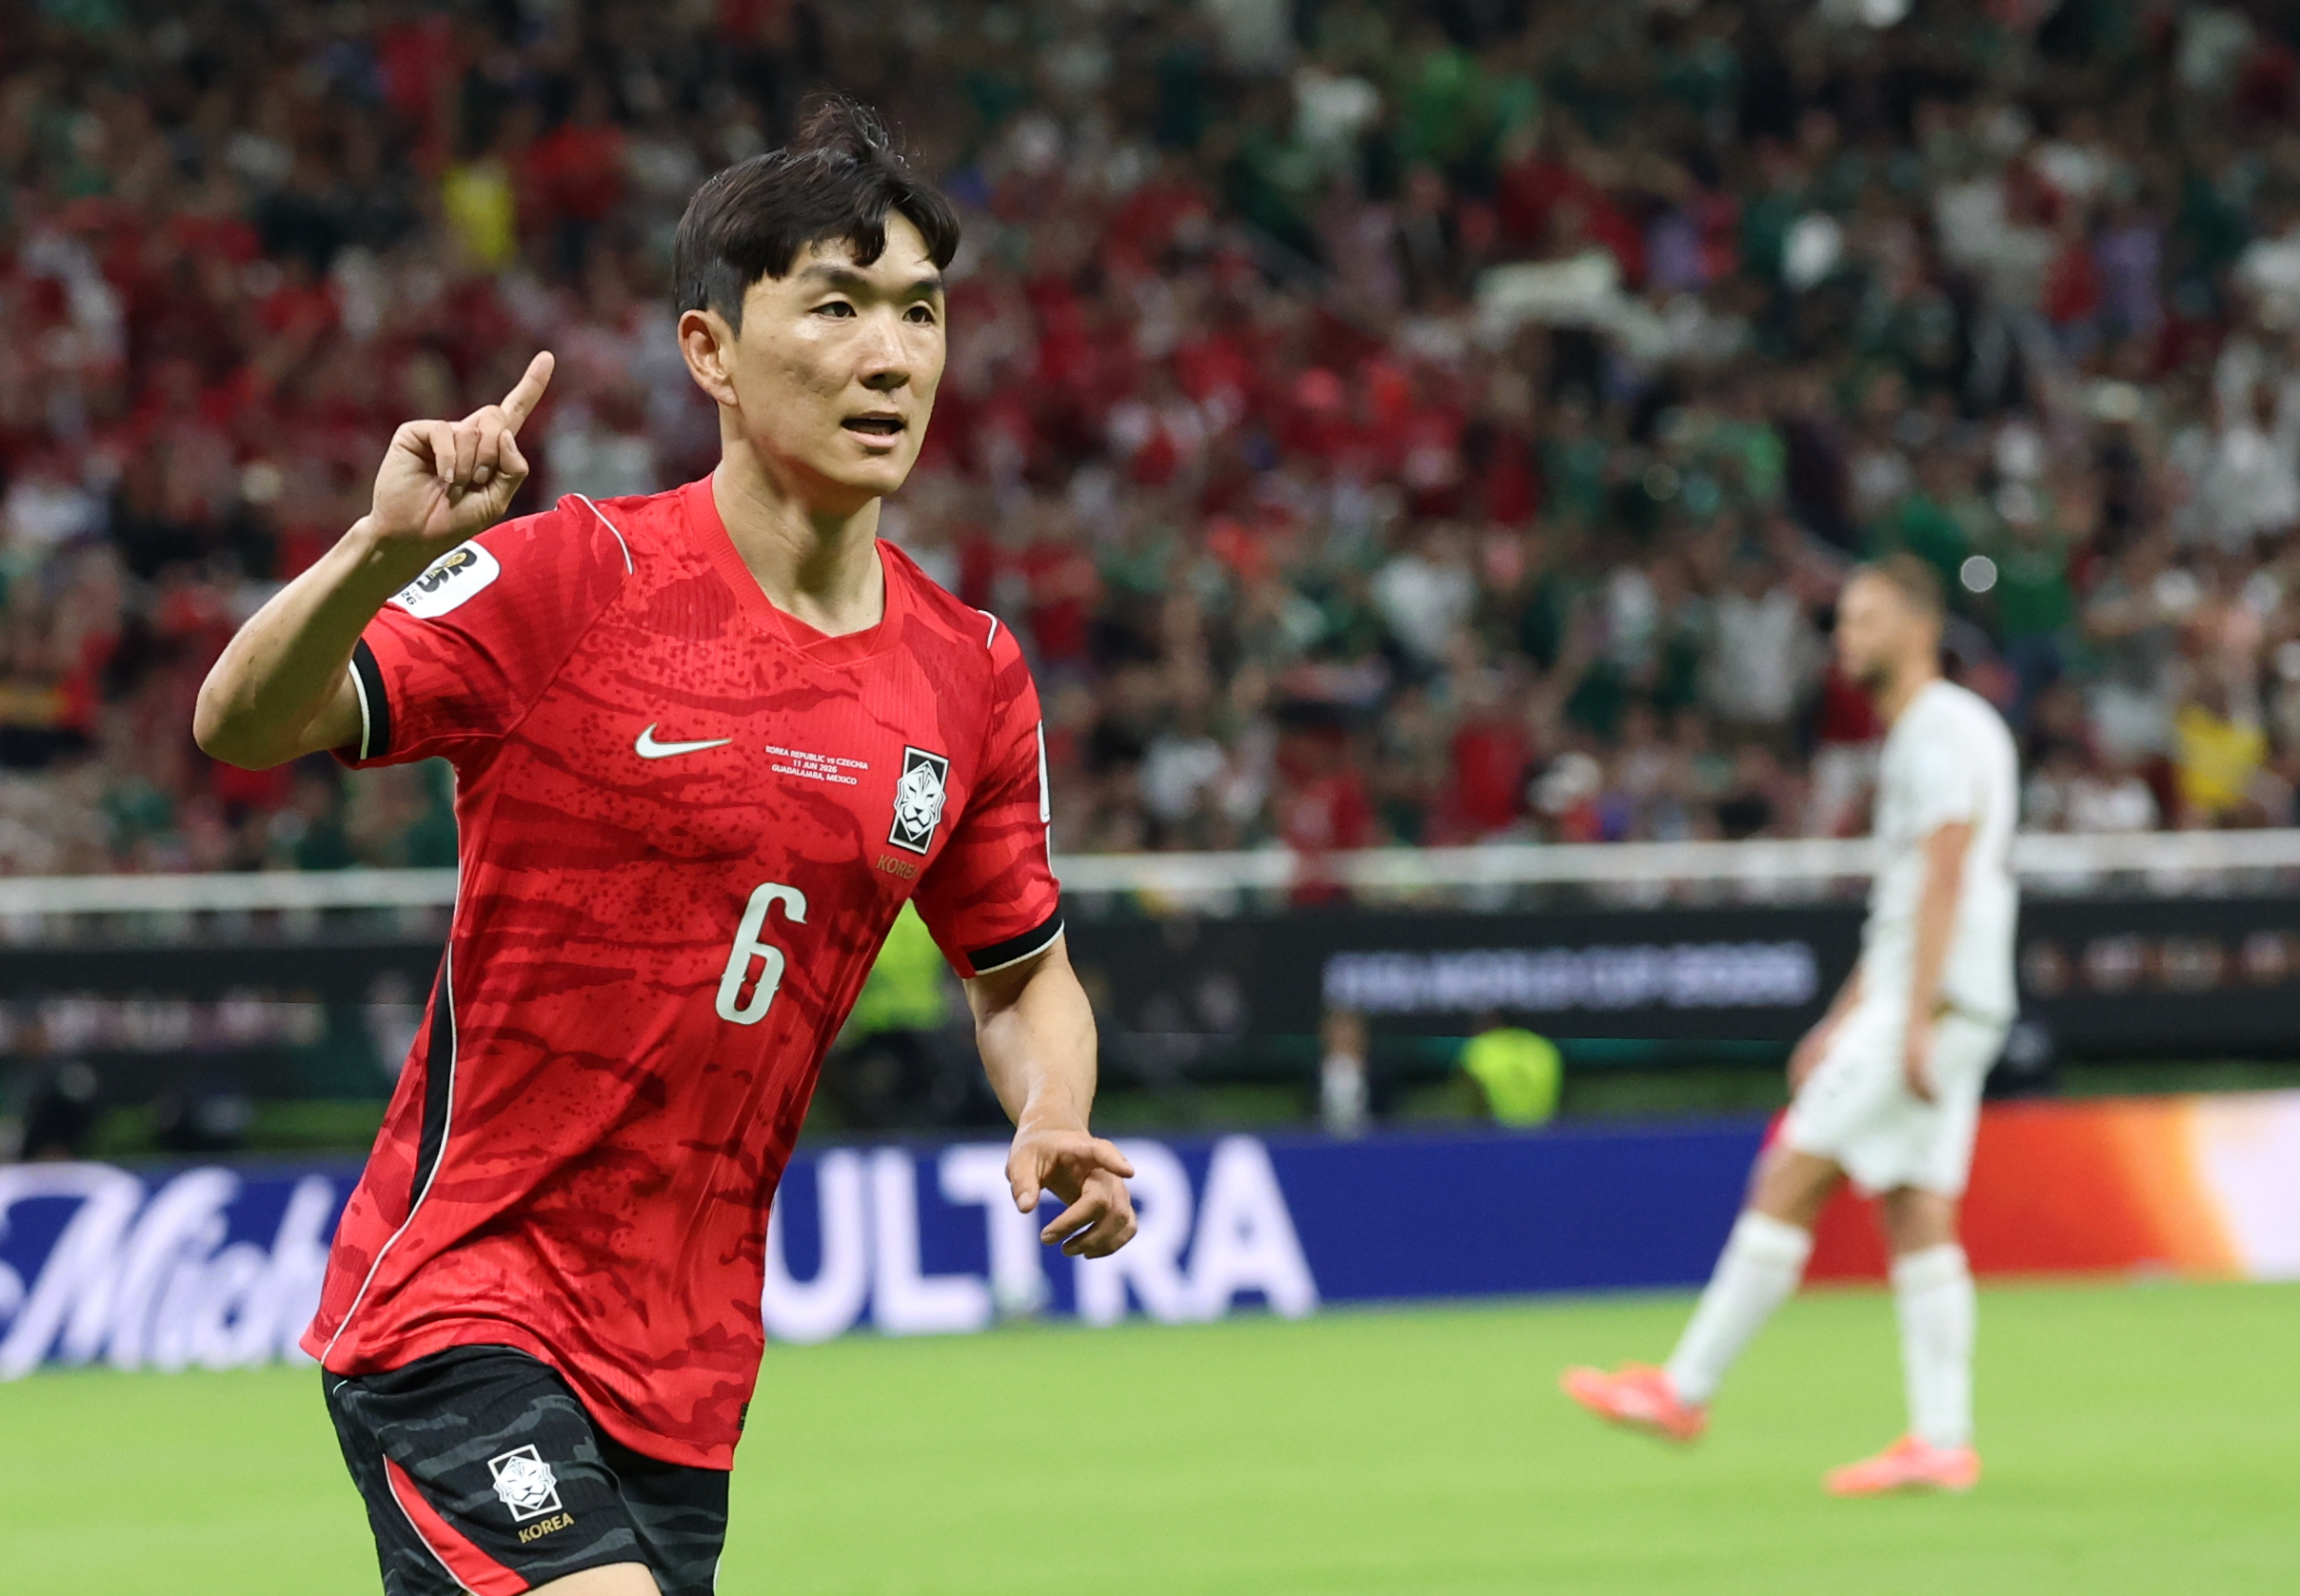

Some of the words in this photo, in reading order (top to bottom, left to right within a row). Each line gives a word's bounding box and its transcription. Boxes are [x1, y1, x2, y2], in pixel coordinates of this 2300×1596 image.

[765, 745, 789, 756] KOREA
[790, 750, 825, 762] REPUBLIC
[836, 758, 868, 769] CZECHIA
[803, 761, 818, 770] JUN
[820, 764, 838, 773] 2026
[772, 764, 824, 780] GUADALAJARA,
[826, 775, 858, 784] MEXICO
[715, 881, 808, 1026] 6
[0, 1163, 330, 1378] Mich
[762, 1134, 1319, 1343] ULTRA
[518, 1512, 575, 1544] KOREA
